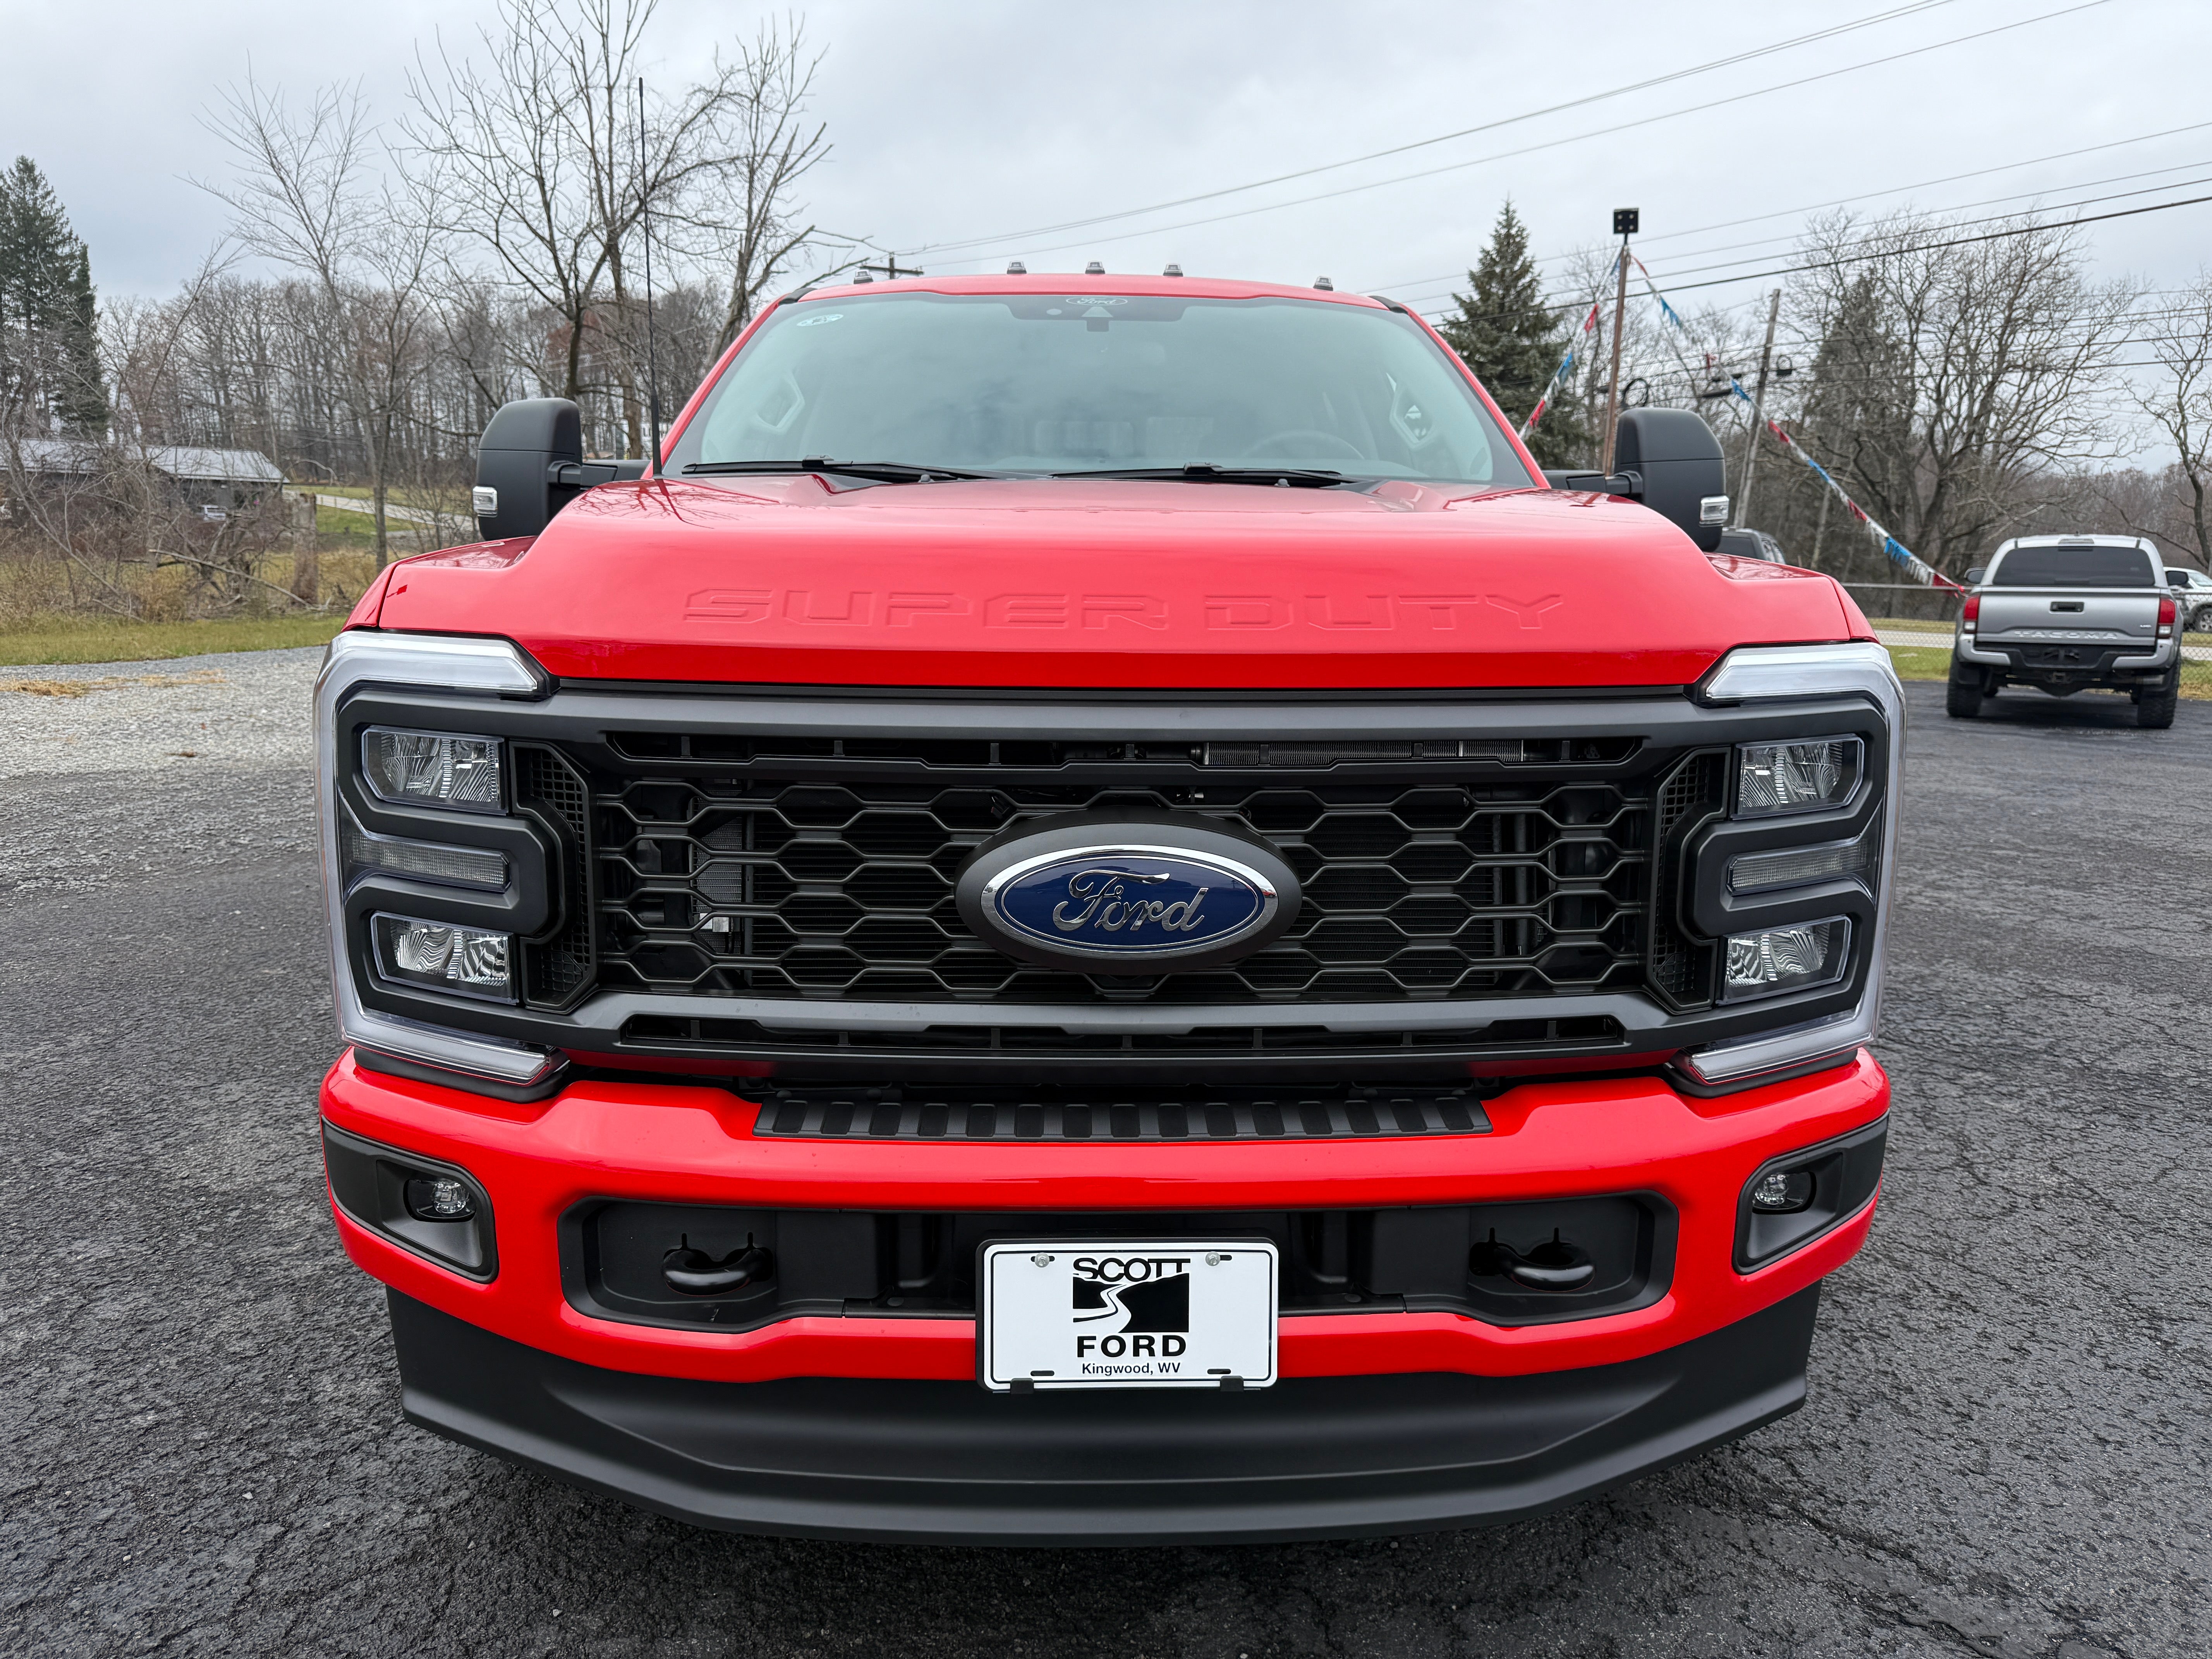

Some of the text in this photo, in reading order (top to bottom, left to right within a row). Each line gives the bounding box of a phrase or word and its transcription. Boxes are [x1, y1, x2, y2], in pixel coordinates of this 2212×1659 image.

[684, 587, 1563, 630] SUPER DUTY
[1052, 869, 1209, 931] Ford
[1073, 1257, 1191, 1282] SCOTT
[1077, 1335, 1186, 1358] FORD
[1082, 1362, 1181, 1376] Kingwood, WV
